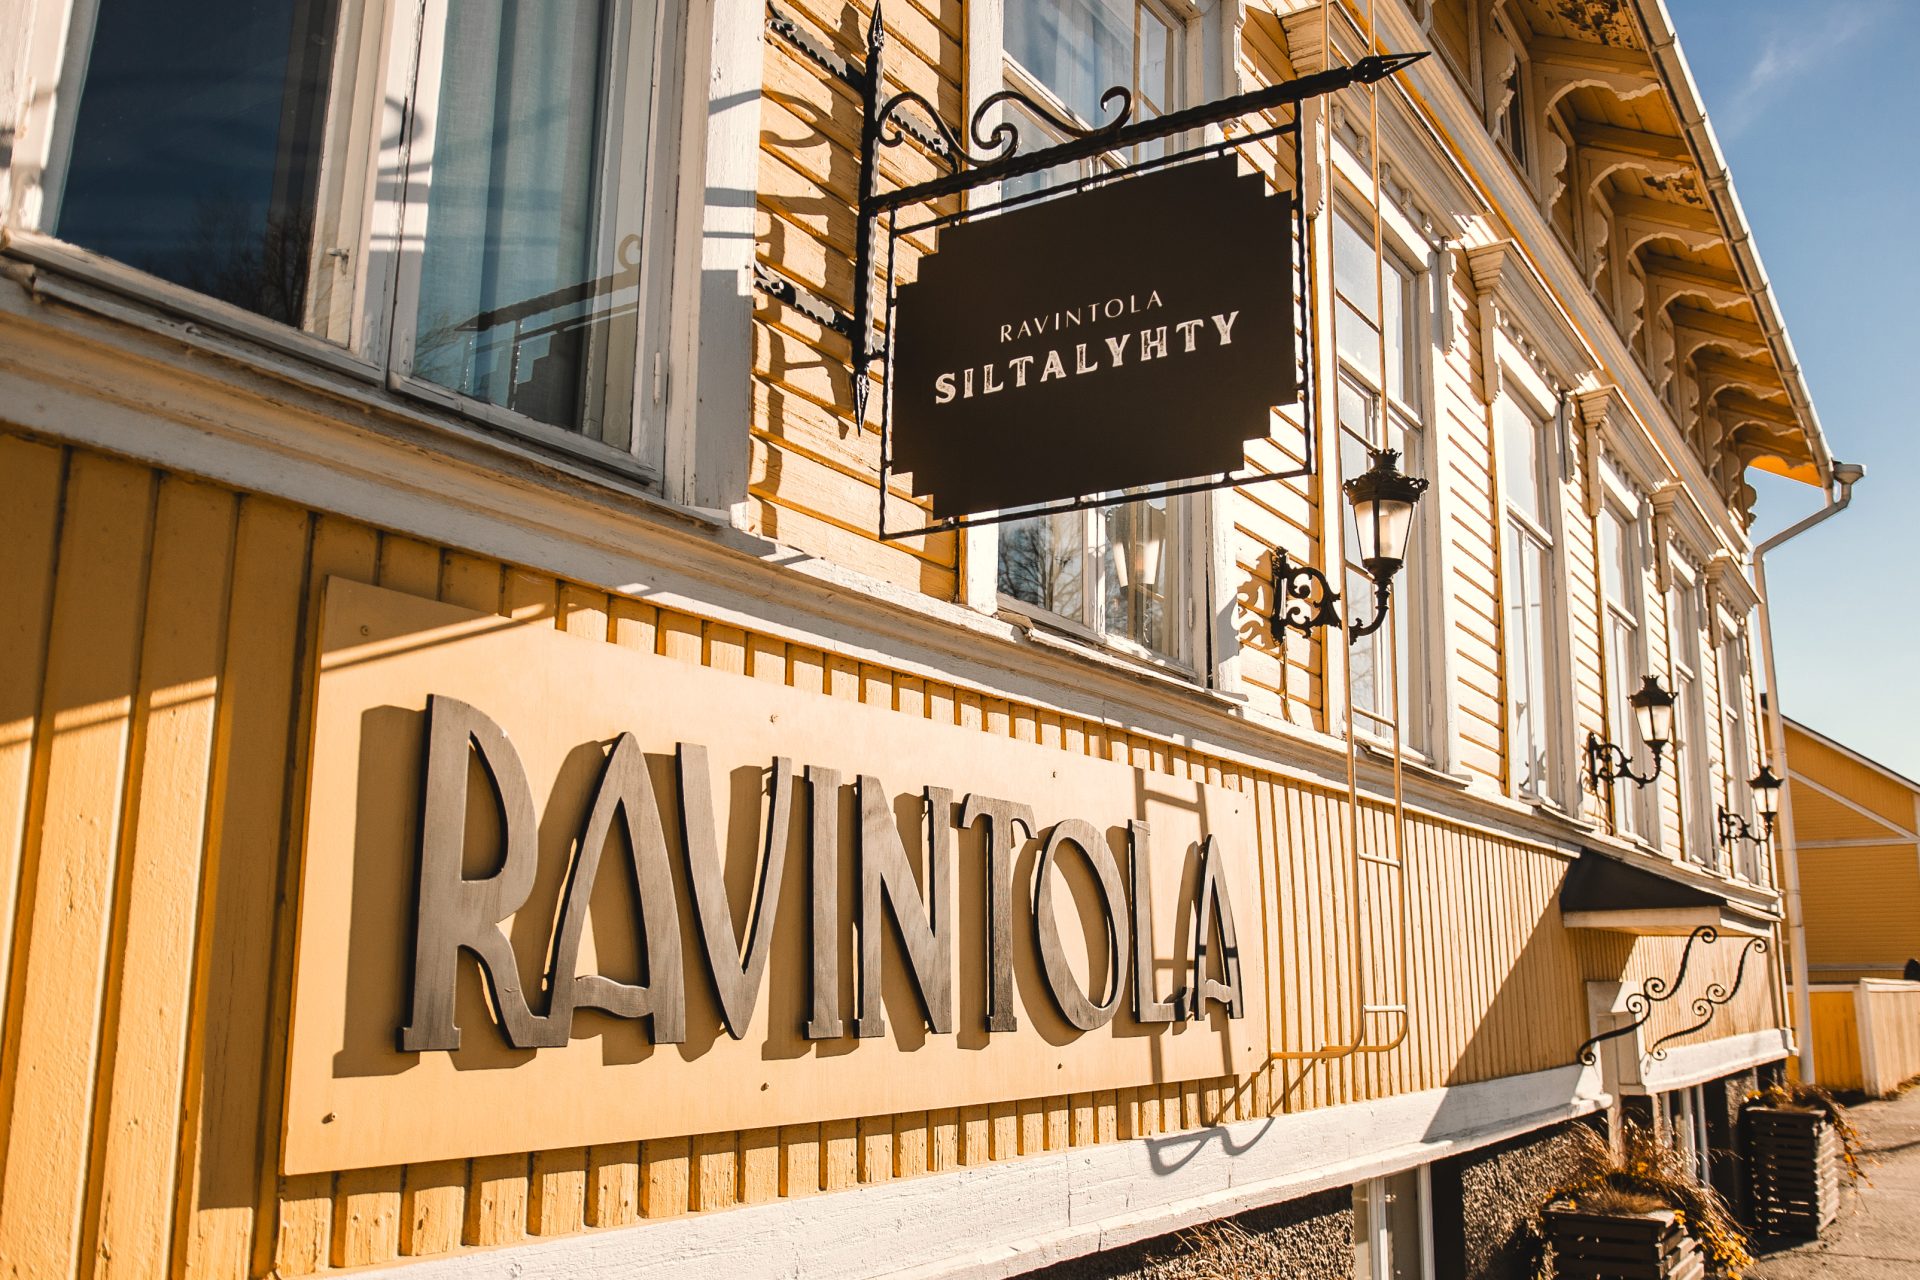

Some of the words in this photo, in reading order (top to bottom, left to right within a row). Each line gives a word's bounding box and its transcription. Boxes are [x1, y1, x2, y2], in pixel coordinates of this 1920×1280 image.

[935, 311, 1240, 404] SILTALYHTY
[1001, 290, 1163, 343] RAVINTOLA
[397, 693, 1245, 1051] RAVINTOLA
